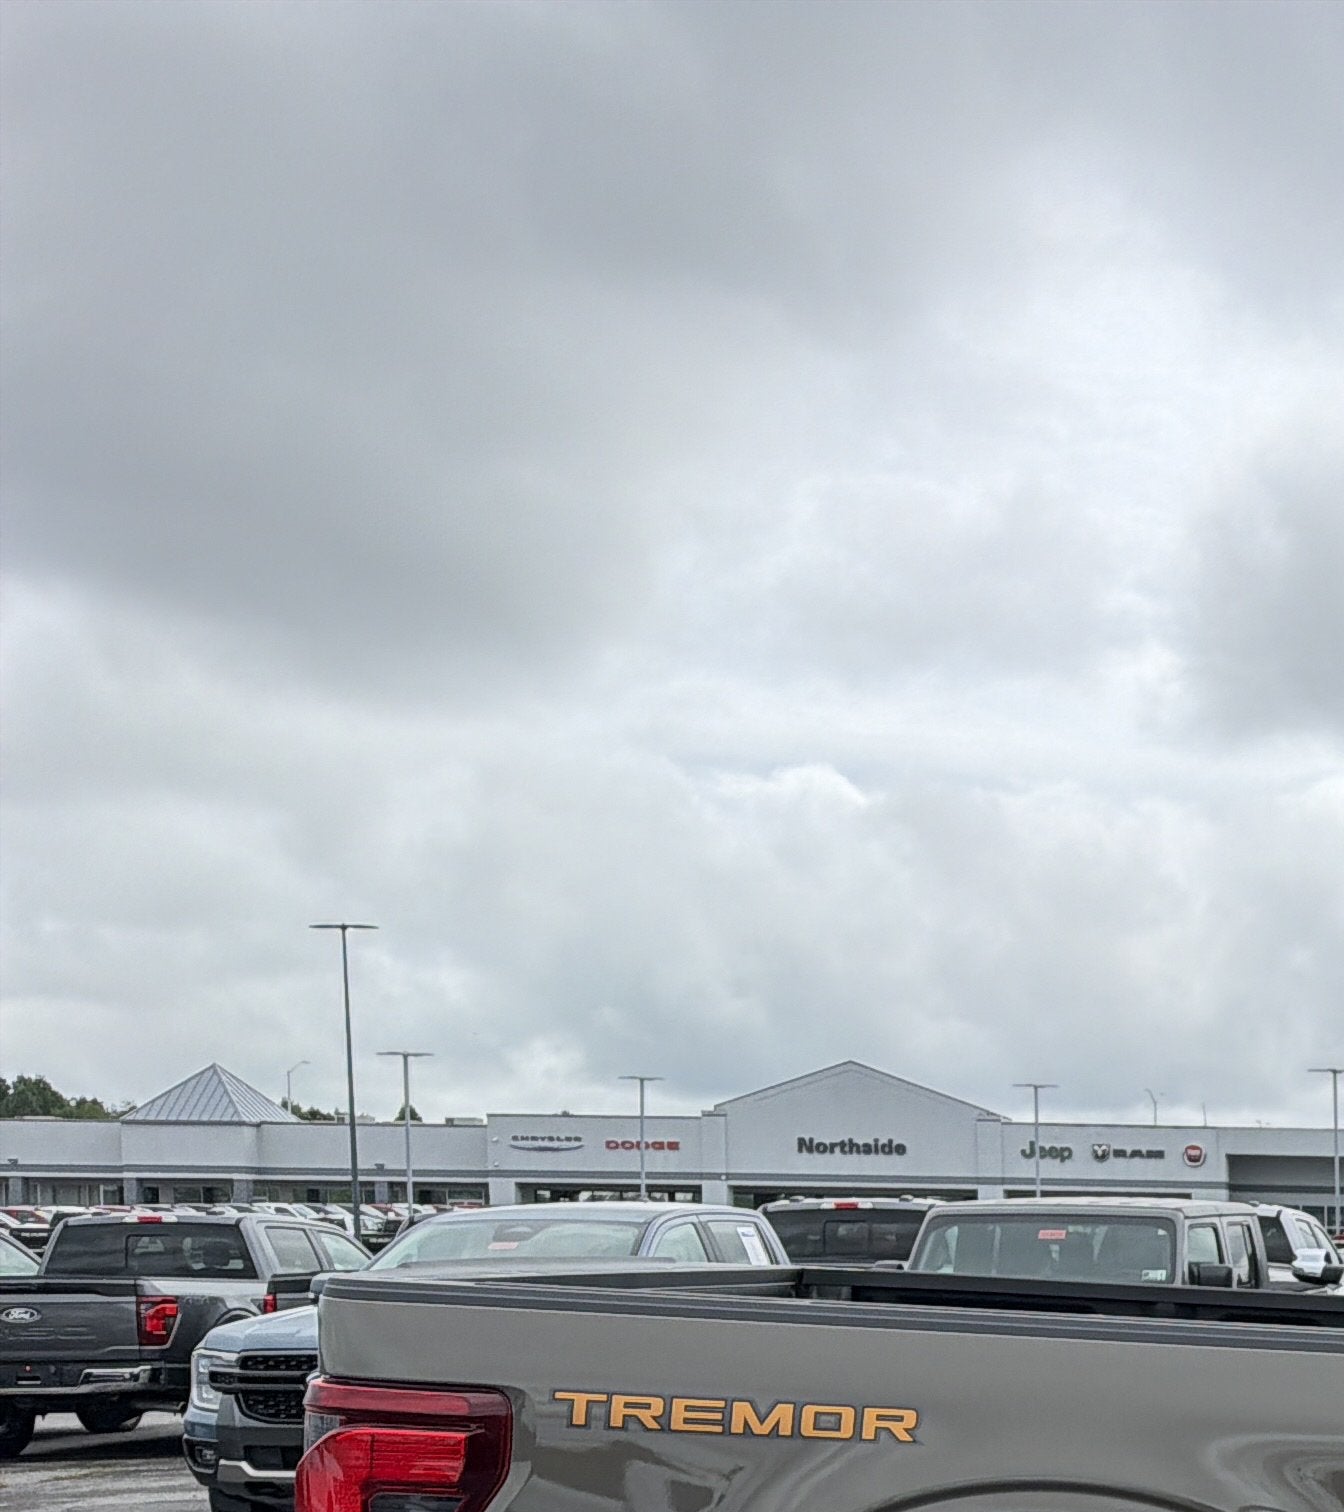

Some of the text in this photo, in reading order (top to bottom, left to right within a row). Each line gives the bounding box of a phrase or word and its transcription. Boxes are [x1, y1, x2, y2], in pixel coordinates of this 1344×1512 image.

[797, 1137, 907, 1156] Northside
[1020, 1140, 1073, 1163] Jeep
[553, 1391, 918, 1442] TREMOR
